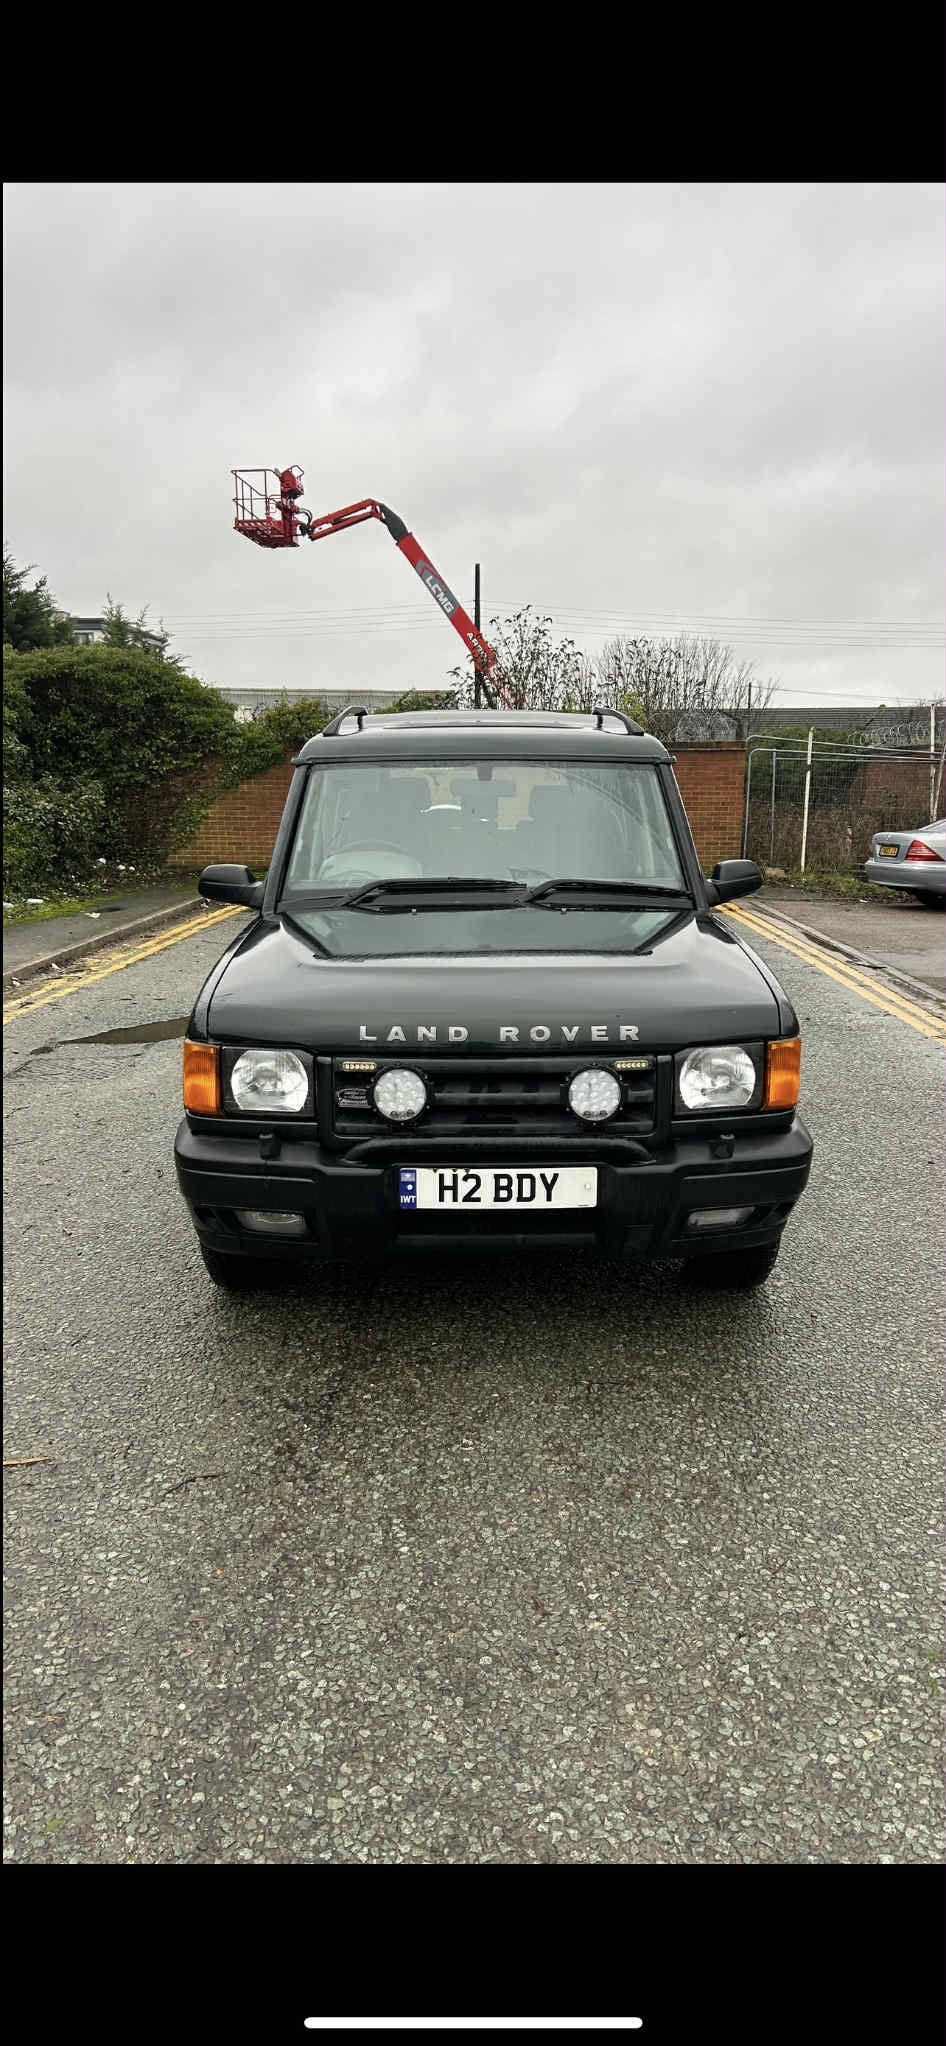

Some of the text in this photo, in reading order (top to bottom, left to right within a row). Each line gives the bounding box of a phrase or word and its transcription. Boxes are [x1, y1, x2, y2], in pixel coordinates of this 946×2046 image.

[359, 1025, 640, 1042] LAND ROVER
[437, 1173, 559, 1202] H2 BDY
